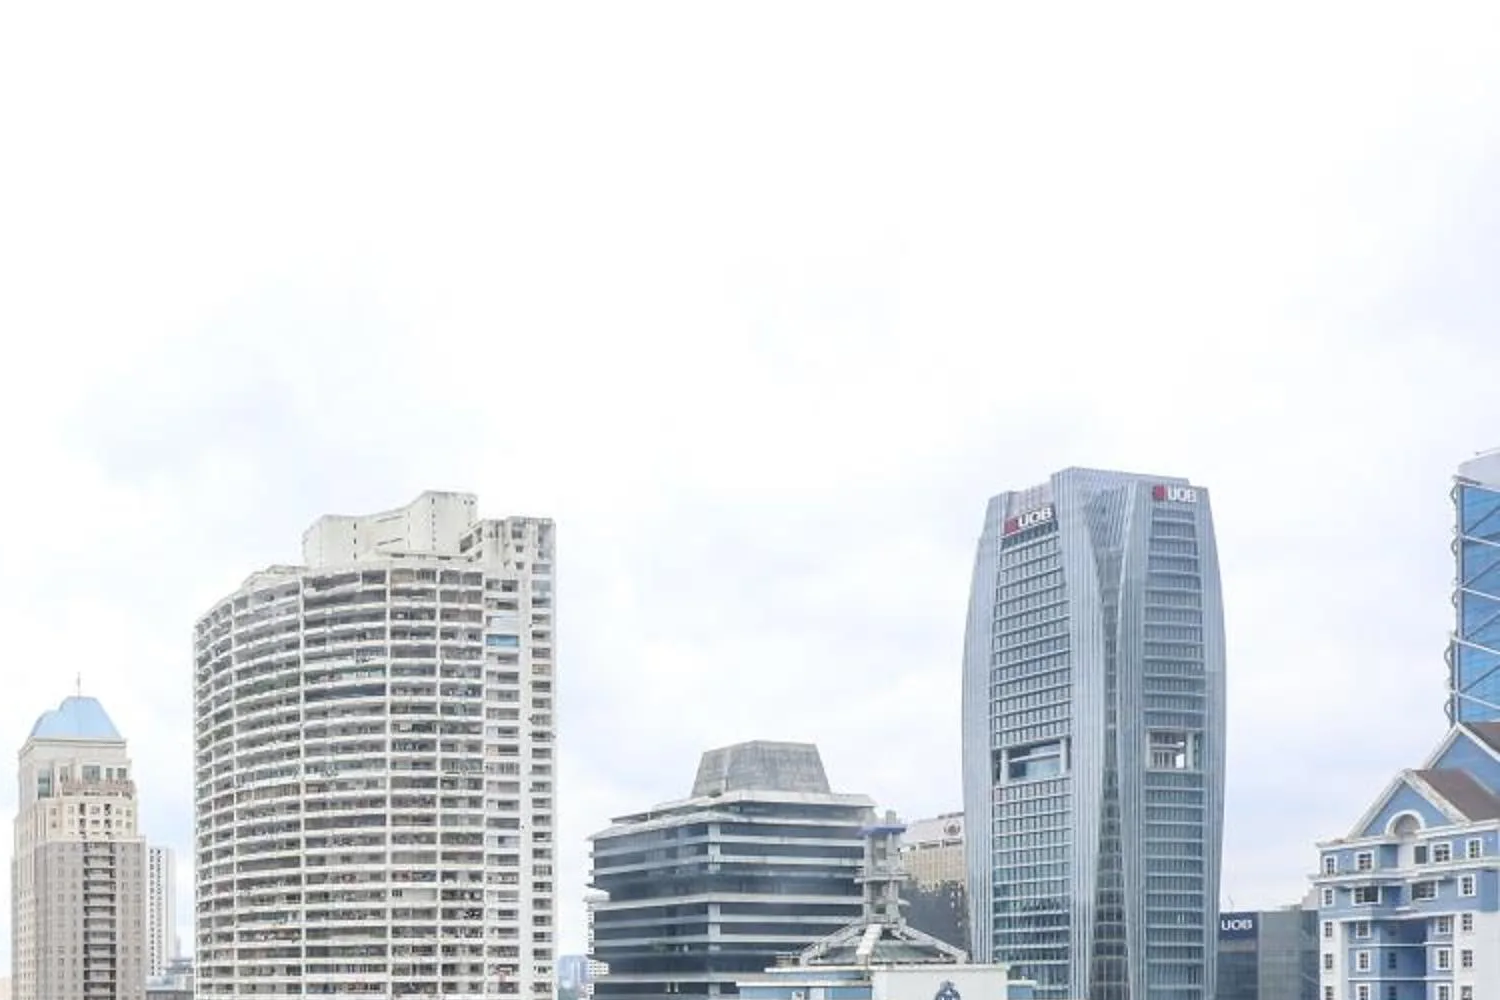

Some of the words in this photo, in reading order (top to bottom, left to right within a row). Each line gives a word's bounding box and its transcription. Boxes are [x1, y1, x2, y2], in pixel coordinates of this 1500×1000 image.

[1168, 487, 1197, 502] UOB
[1018, 507, 1052, 527] UOB
[1221, 919, 1252, 931] UOB
